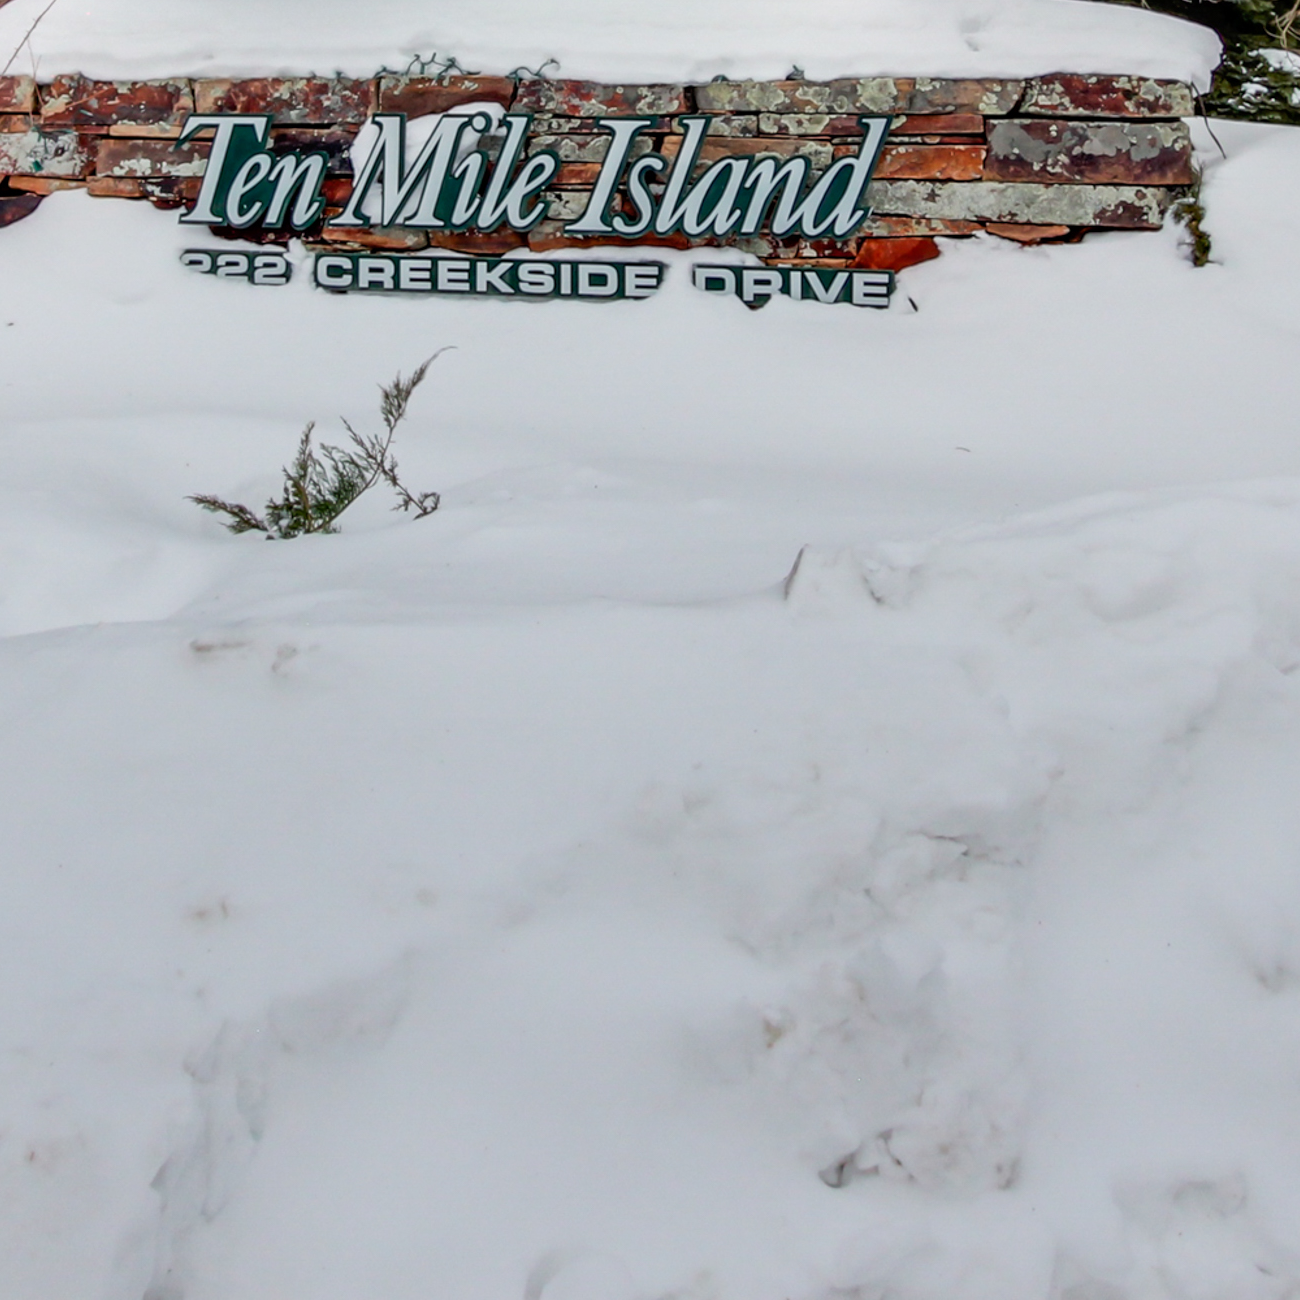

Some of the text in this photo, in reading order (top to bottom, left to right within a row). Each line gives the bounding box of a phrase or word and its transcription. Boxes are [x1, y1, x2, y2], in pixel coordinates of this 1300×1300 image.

[177, 112, 892, 238] Ten Mile Island
[316, 255, 660, 298] CREEKSIDE
[694, 267, 891, 306] DRIVE
